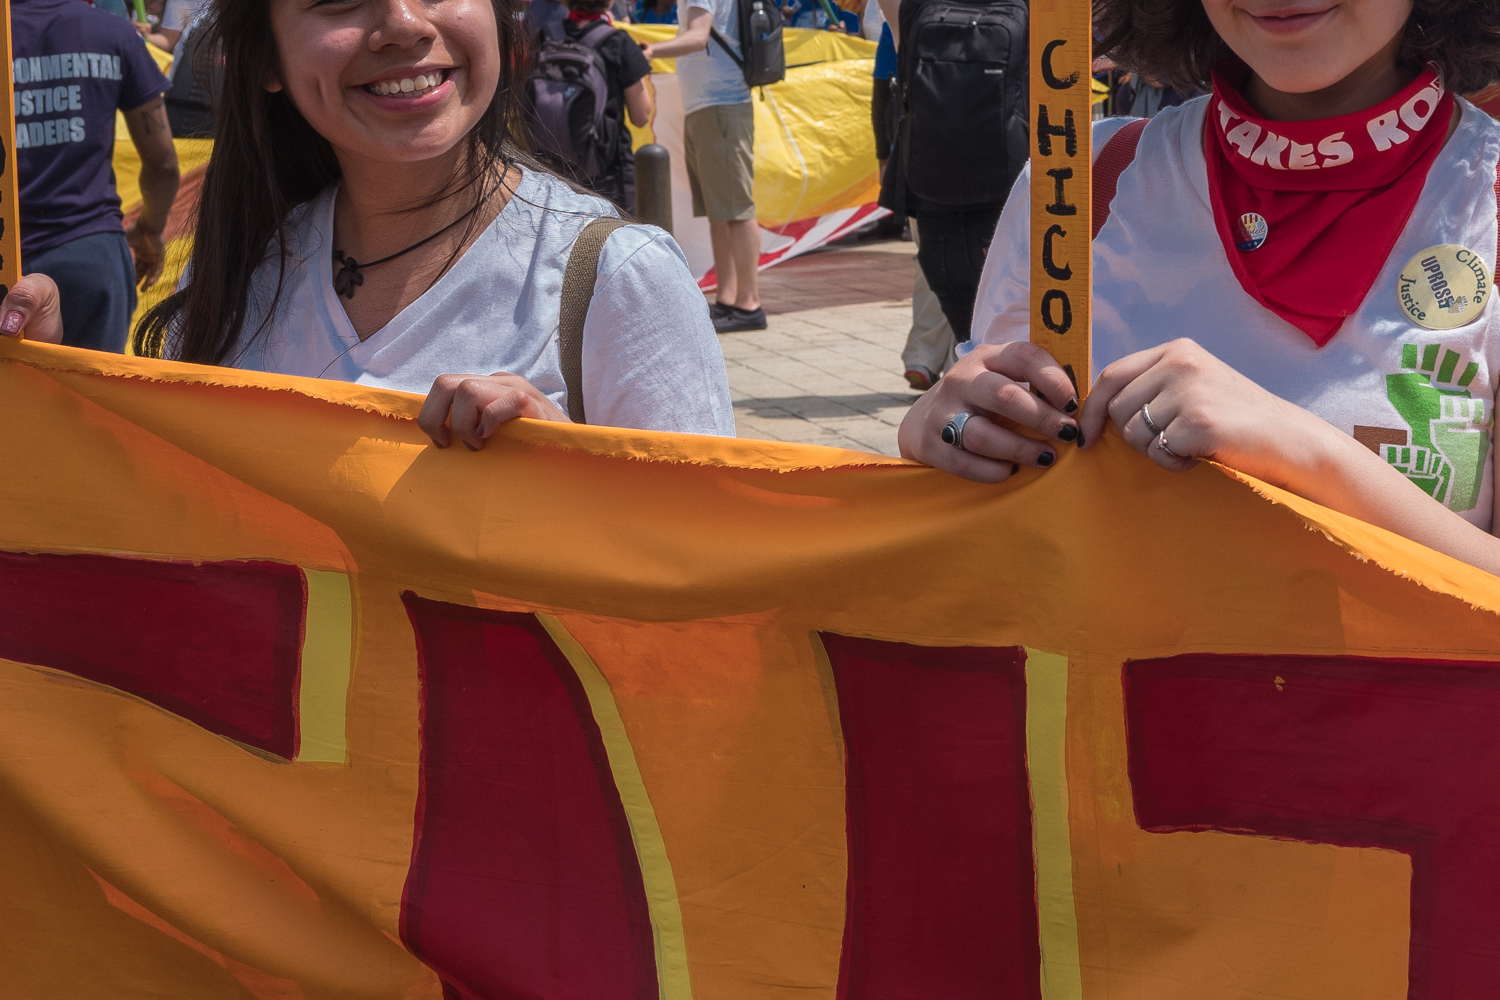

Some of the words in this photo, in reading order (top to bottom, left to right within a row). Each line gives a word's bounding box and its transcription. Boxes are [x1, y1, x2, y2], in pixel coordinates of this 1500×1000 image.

[1217, 99, 1355, 171] TAKES
[1036, 38, 1081, 335] CHICO
[1400, 274, 1427, 321] Justice
[1456, 249, 1487, 304] Climate
